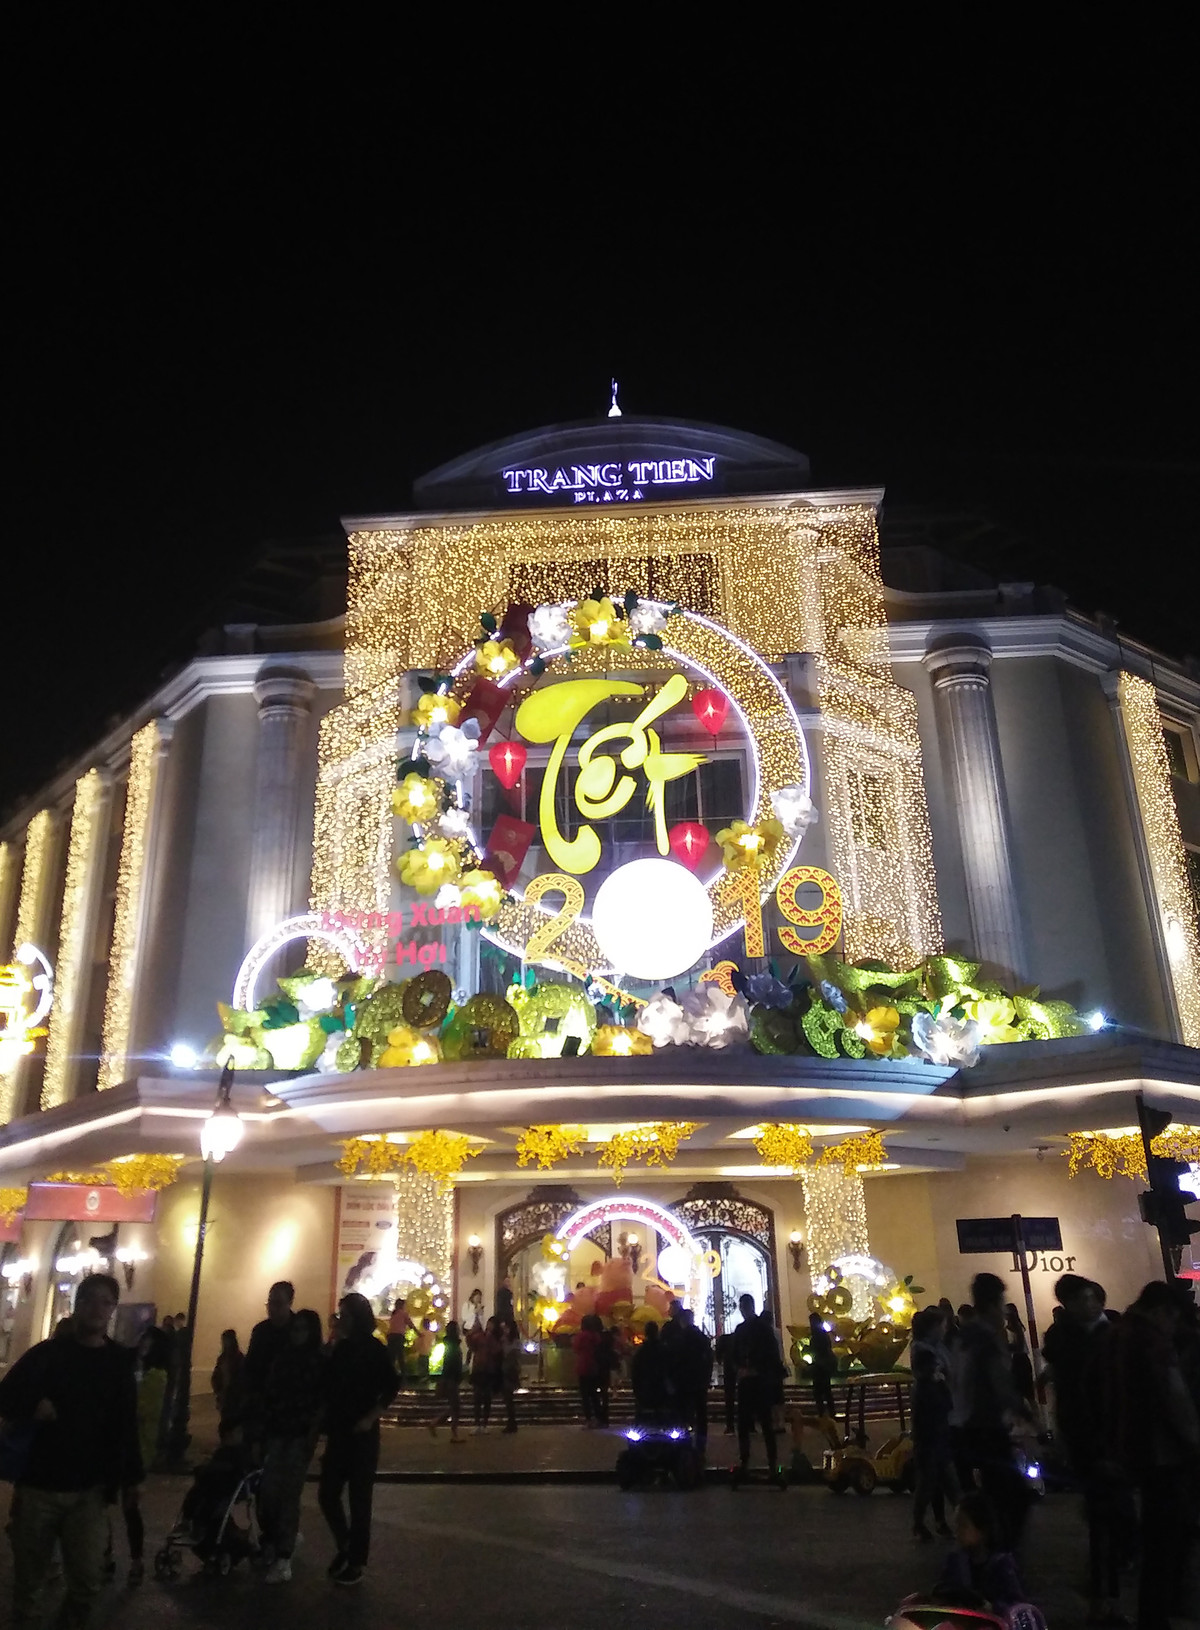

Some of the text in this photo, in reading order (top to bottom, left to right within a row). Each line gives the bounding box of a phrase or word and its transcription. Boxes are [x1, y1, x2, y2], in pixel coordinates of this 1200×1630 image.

[503, 457, 715, 493] TRANG TIEN
[574, 488, 644, 504] PLAZA
[1009, 1249, 1077, 1273] Dior
